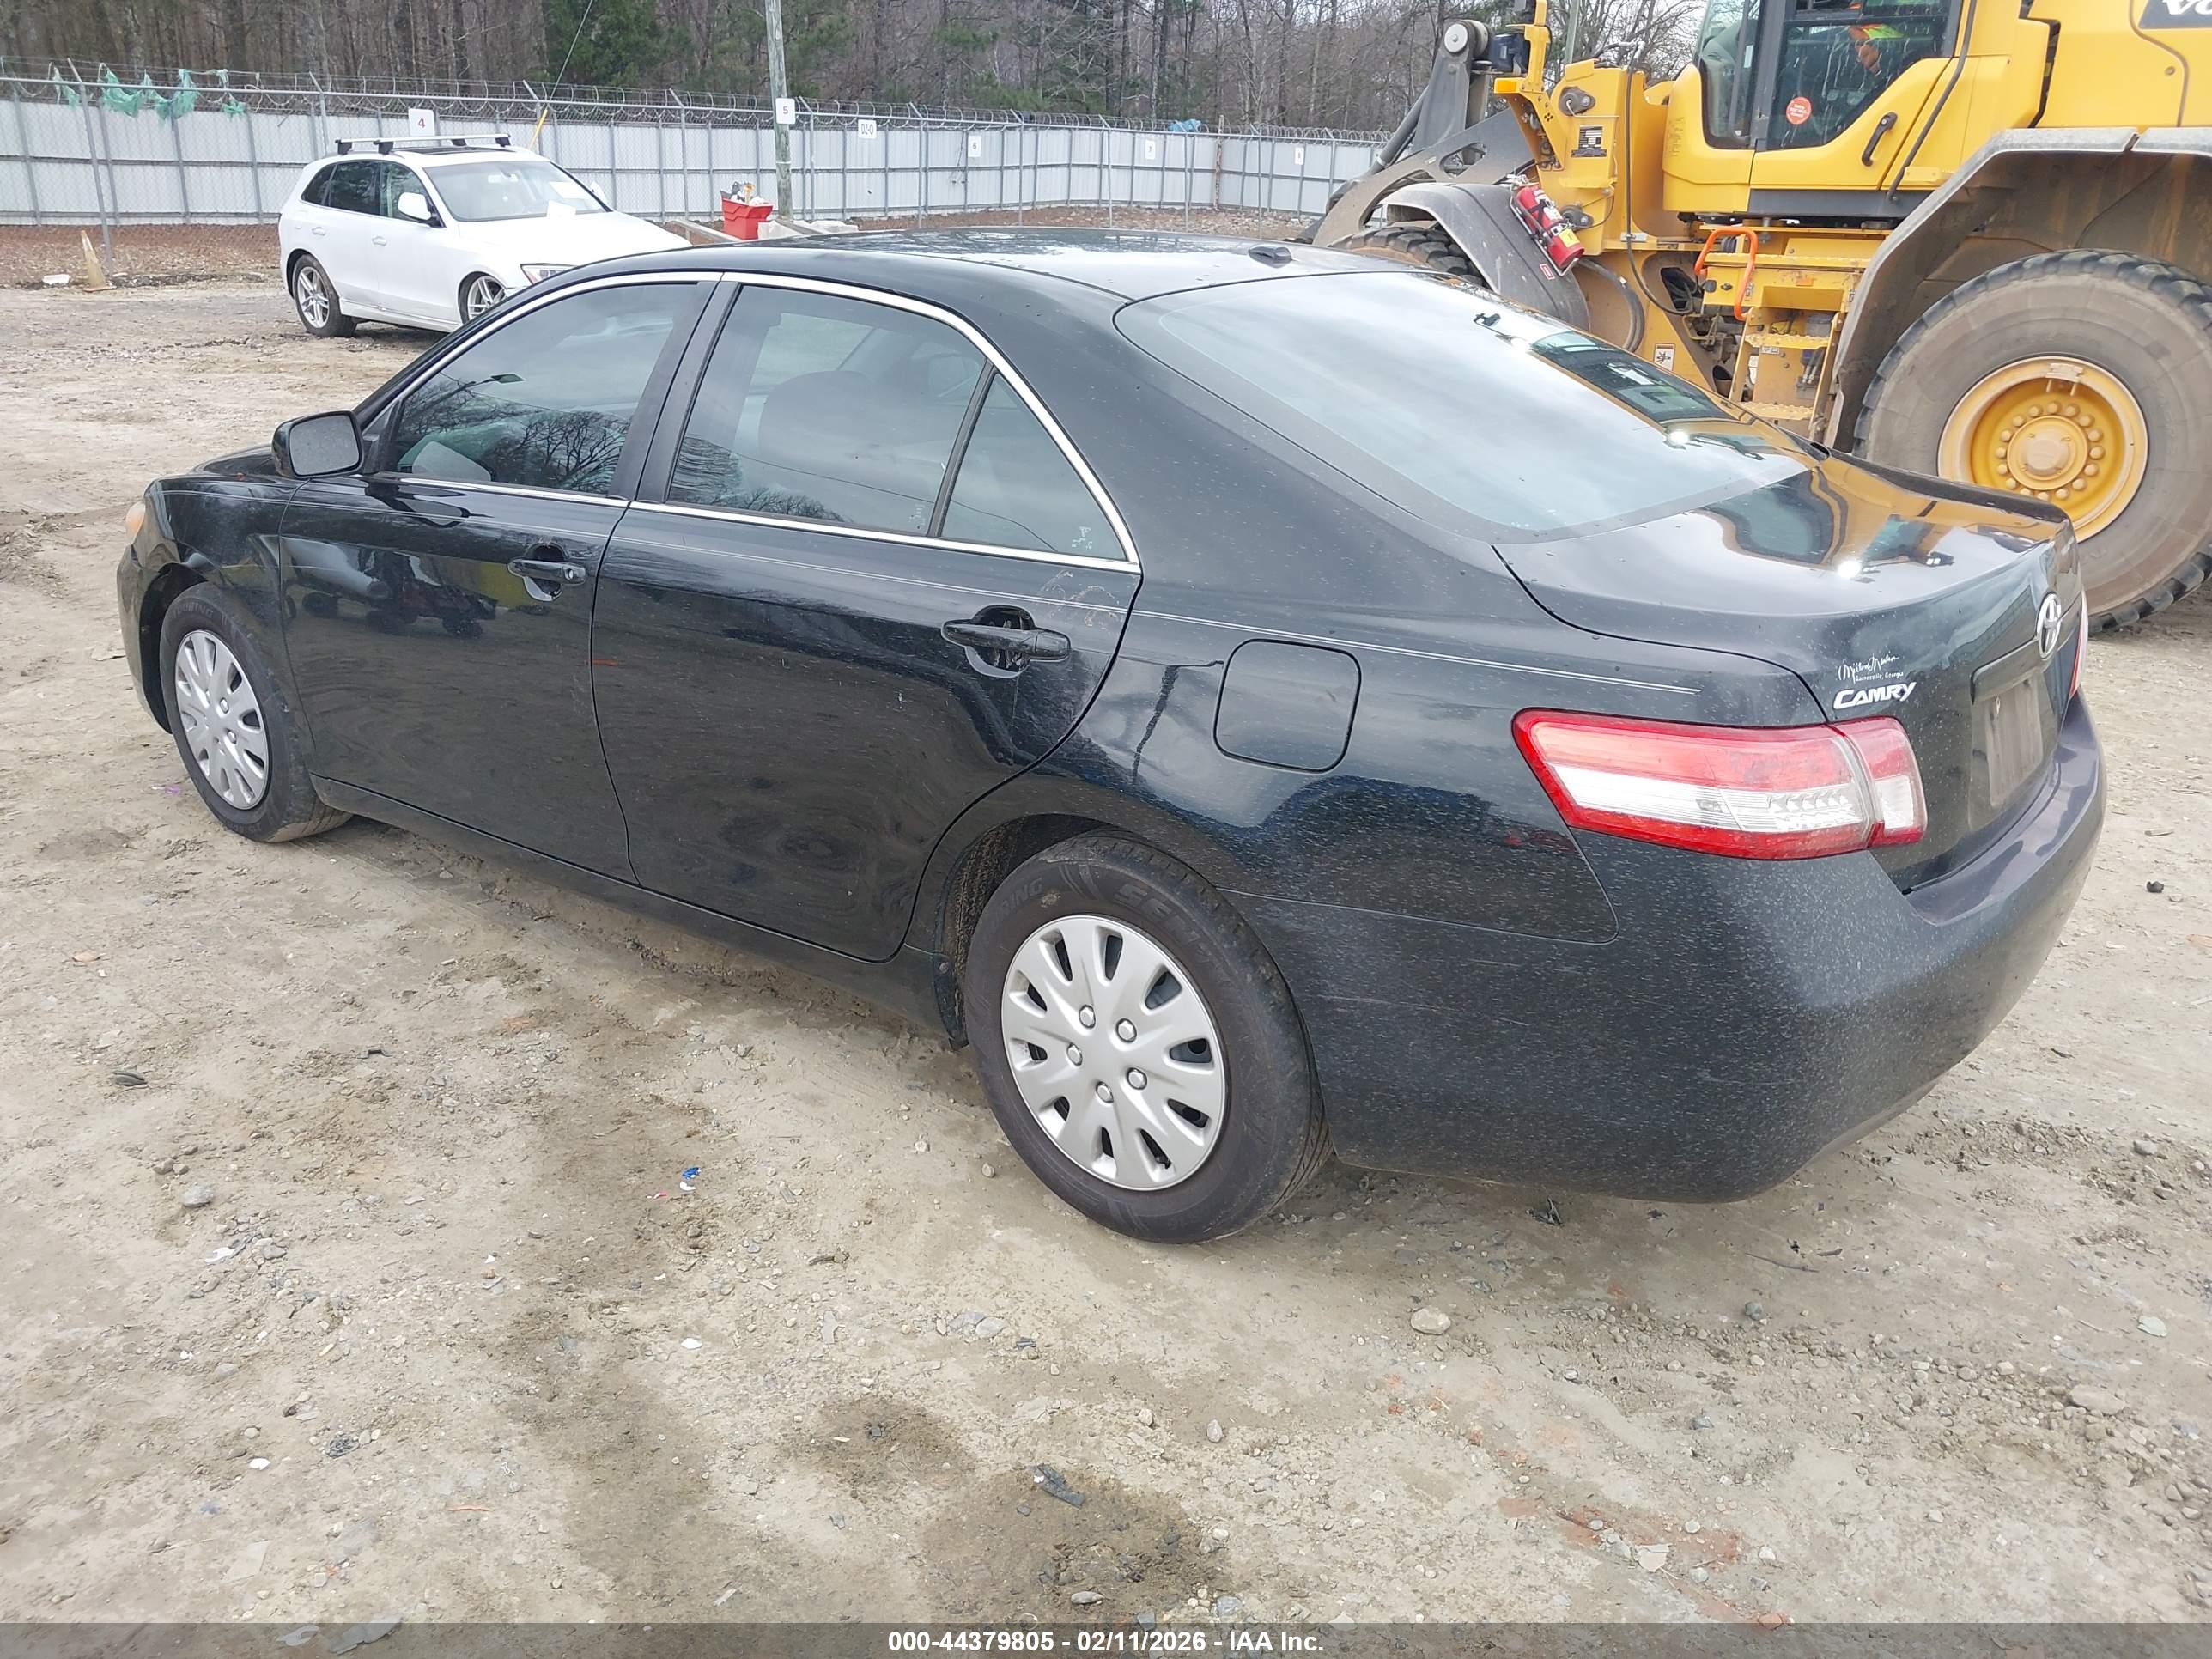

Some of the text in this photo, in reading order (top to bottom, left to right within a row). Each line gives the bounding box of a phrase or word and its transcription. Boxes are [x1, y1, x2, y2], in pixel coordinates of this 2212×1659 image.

[782, 106, 789, 115] 5
[418, 118, 426, 128] 4
[1833, 682, 1917, 709] CAMRY
